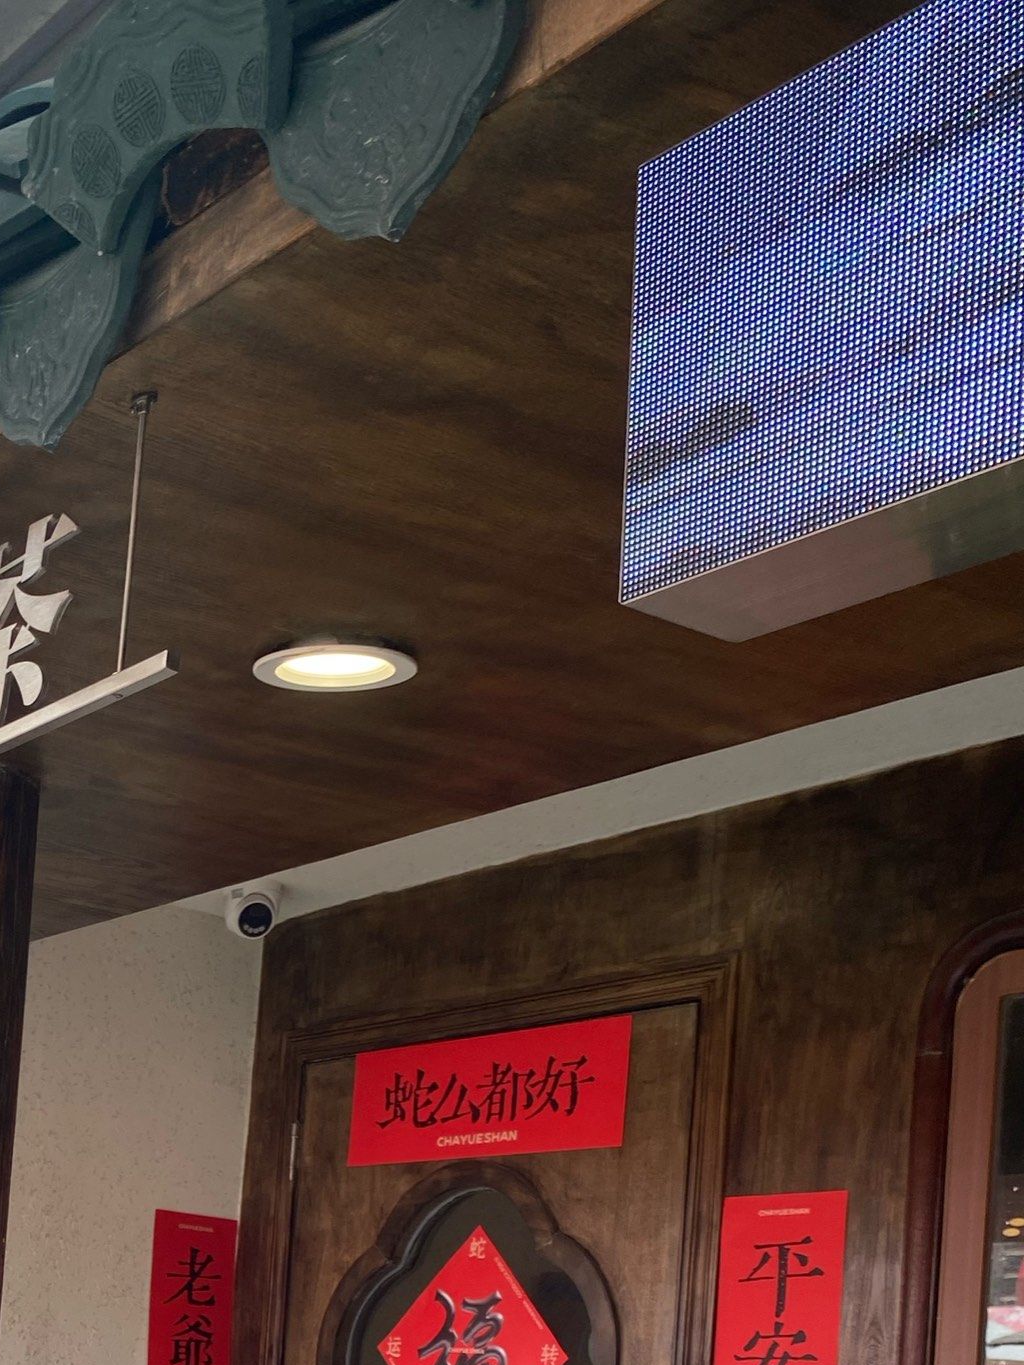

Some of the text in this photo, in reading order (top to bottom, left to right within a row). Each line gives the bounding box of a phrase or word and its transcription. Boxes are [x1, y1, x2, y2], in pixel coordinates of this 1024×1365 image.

[377, 1055, 595, 1129] 蛇么都好
[437, 1130, 518, 1148] CHAYUESHAN
[468, 1237, 488, 1260] 蛇
[386, 1336, 403, 1358] 运
